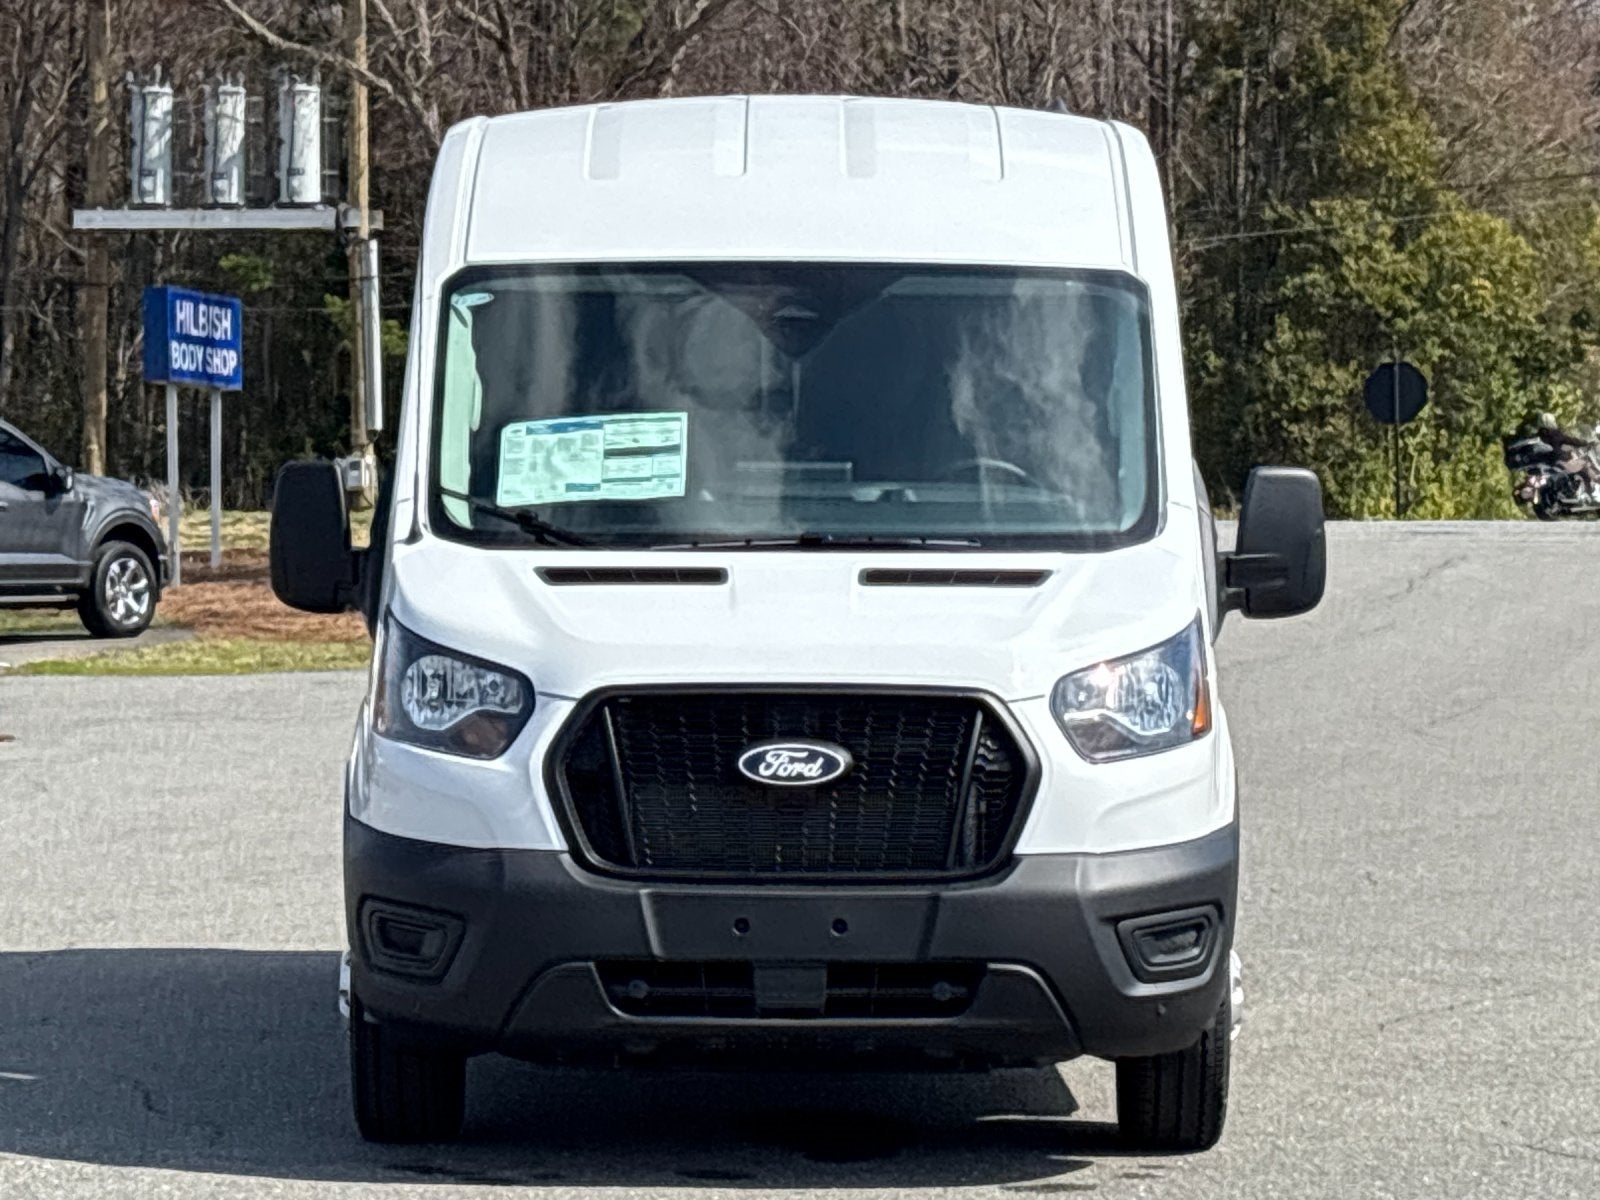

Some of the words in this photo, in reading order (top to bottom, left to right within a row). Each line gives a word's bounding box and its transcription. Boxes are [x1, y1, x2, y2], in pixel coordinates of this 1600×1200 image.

[176, 300, 232, 340] HILBISH
[171, 340, 204, 372] BODY
[205, 346, 237, 376] SHOP
[759, 750, 825, 777] Ford
